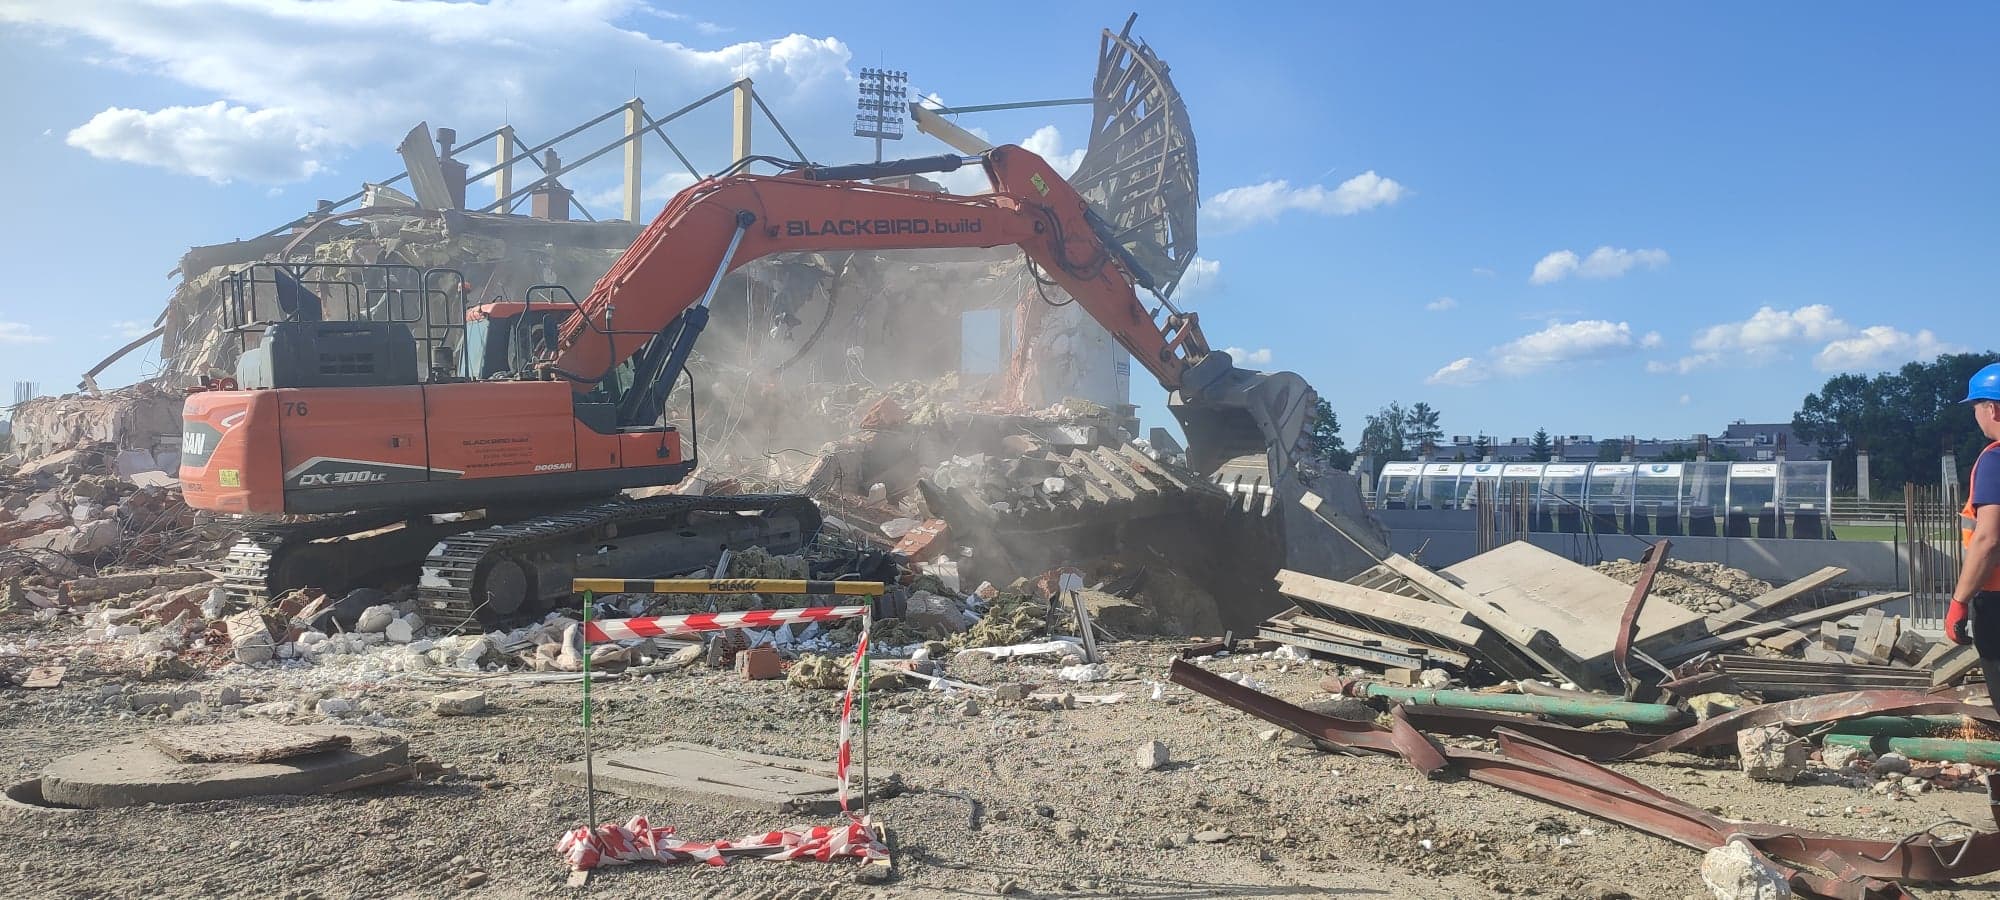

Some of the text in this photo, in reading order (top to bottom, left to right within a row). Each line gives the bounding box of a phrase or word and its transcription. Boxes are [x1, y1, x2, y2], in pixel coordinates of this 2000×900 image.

[786, 218, 982, 237] BLACKBIRD.build
[284, 402, 308, 417] 76
[534, 462, 573, 472] DOOSAN
[709, 583, 757, 592] POLANIK
